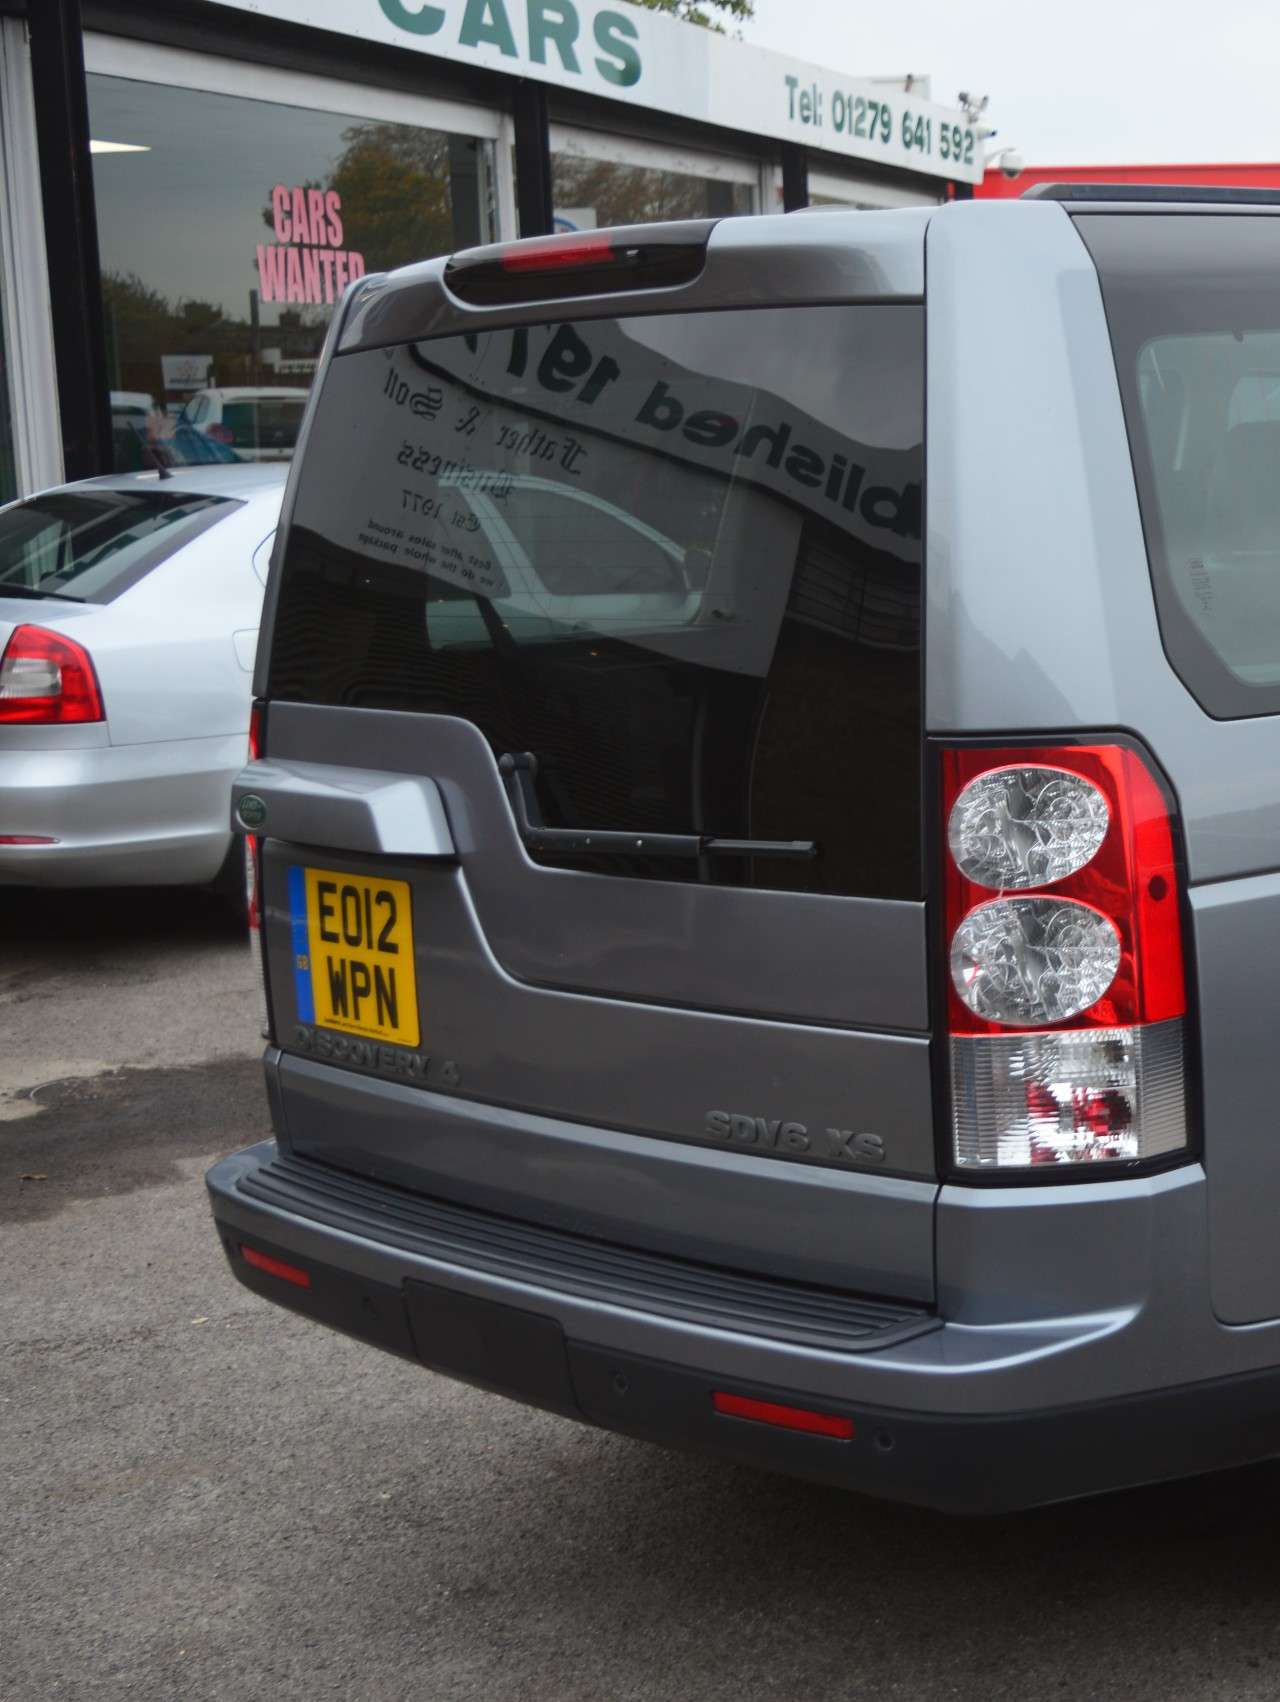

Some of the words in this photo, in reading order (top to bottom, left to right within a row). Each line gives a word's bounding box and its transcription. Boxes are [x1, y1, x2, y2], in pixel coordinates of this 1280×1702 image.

[785, 75, 822, 126] Tel:
[832, 90, 892, 144] 01279
[902, 111, 931, 154] 641
[940, 121, 974, 165] 592
[272, 184, 344, 247] CARS
[317, 880, 399, 954] EO12
[327, 956, 399, 1028] WPN
[291, 1024, 431, 1077] DISCOVERY
[441, 1060, 460, 1087] 4
[705, 1110, 811, 1152] SDV6
[825, 1128, 886, 1162] XS
